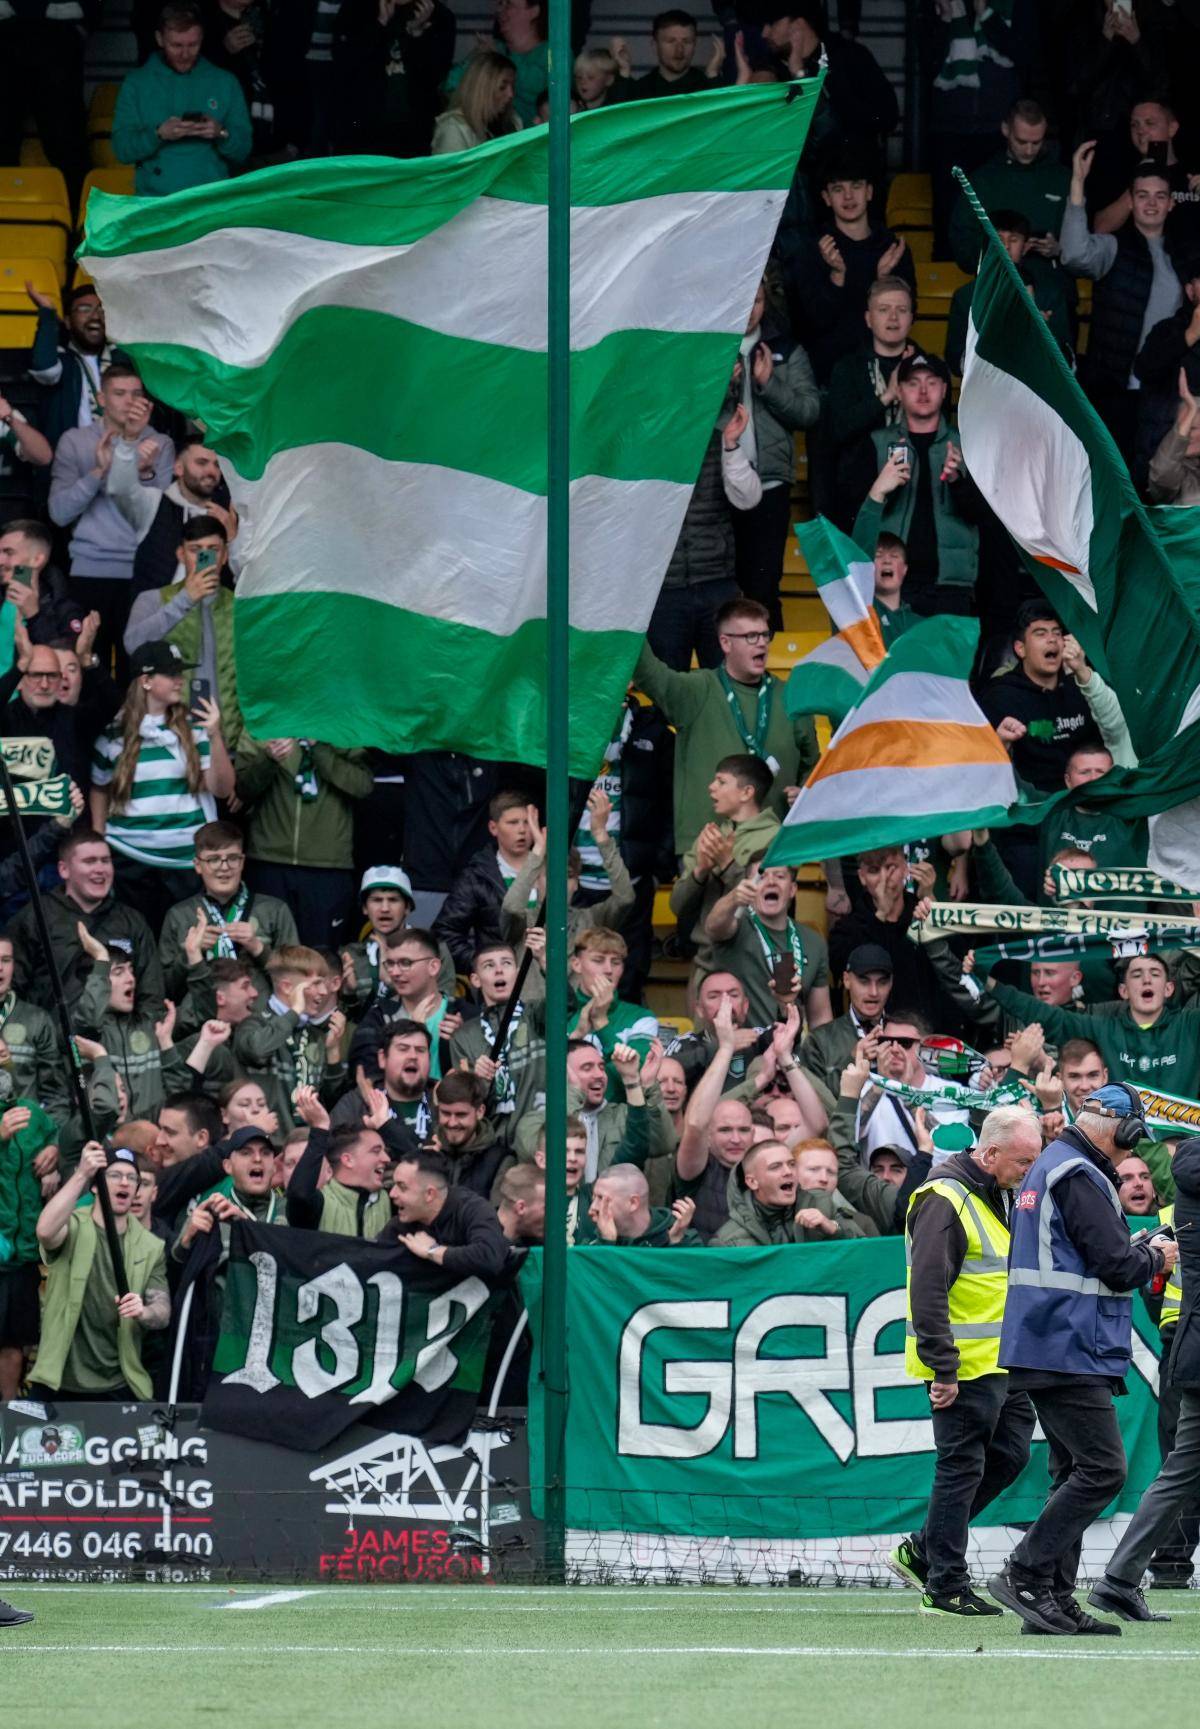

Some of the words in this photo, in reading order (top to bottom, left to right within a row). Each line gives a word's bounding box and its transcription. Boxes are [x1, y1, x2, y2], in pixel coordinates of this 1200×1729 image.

[994, 910, 1033, 930] OF
[82, 1531, 142, 1559] 046
[343, 1529, 449, 1554] JAMES
